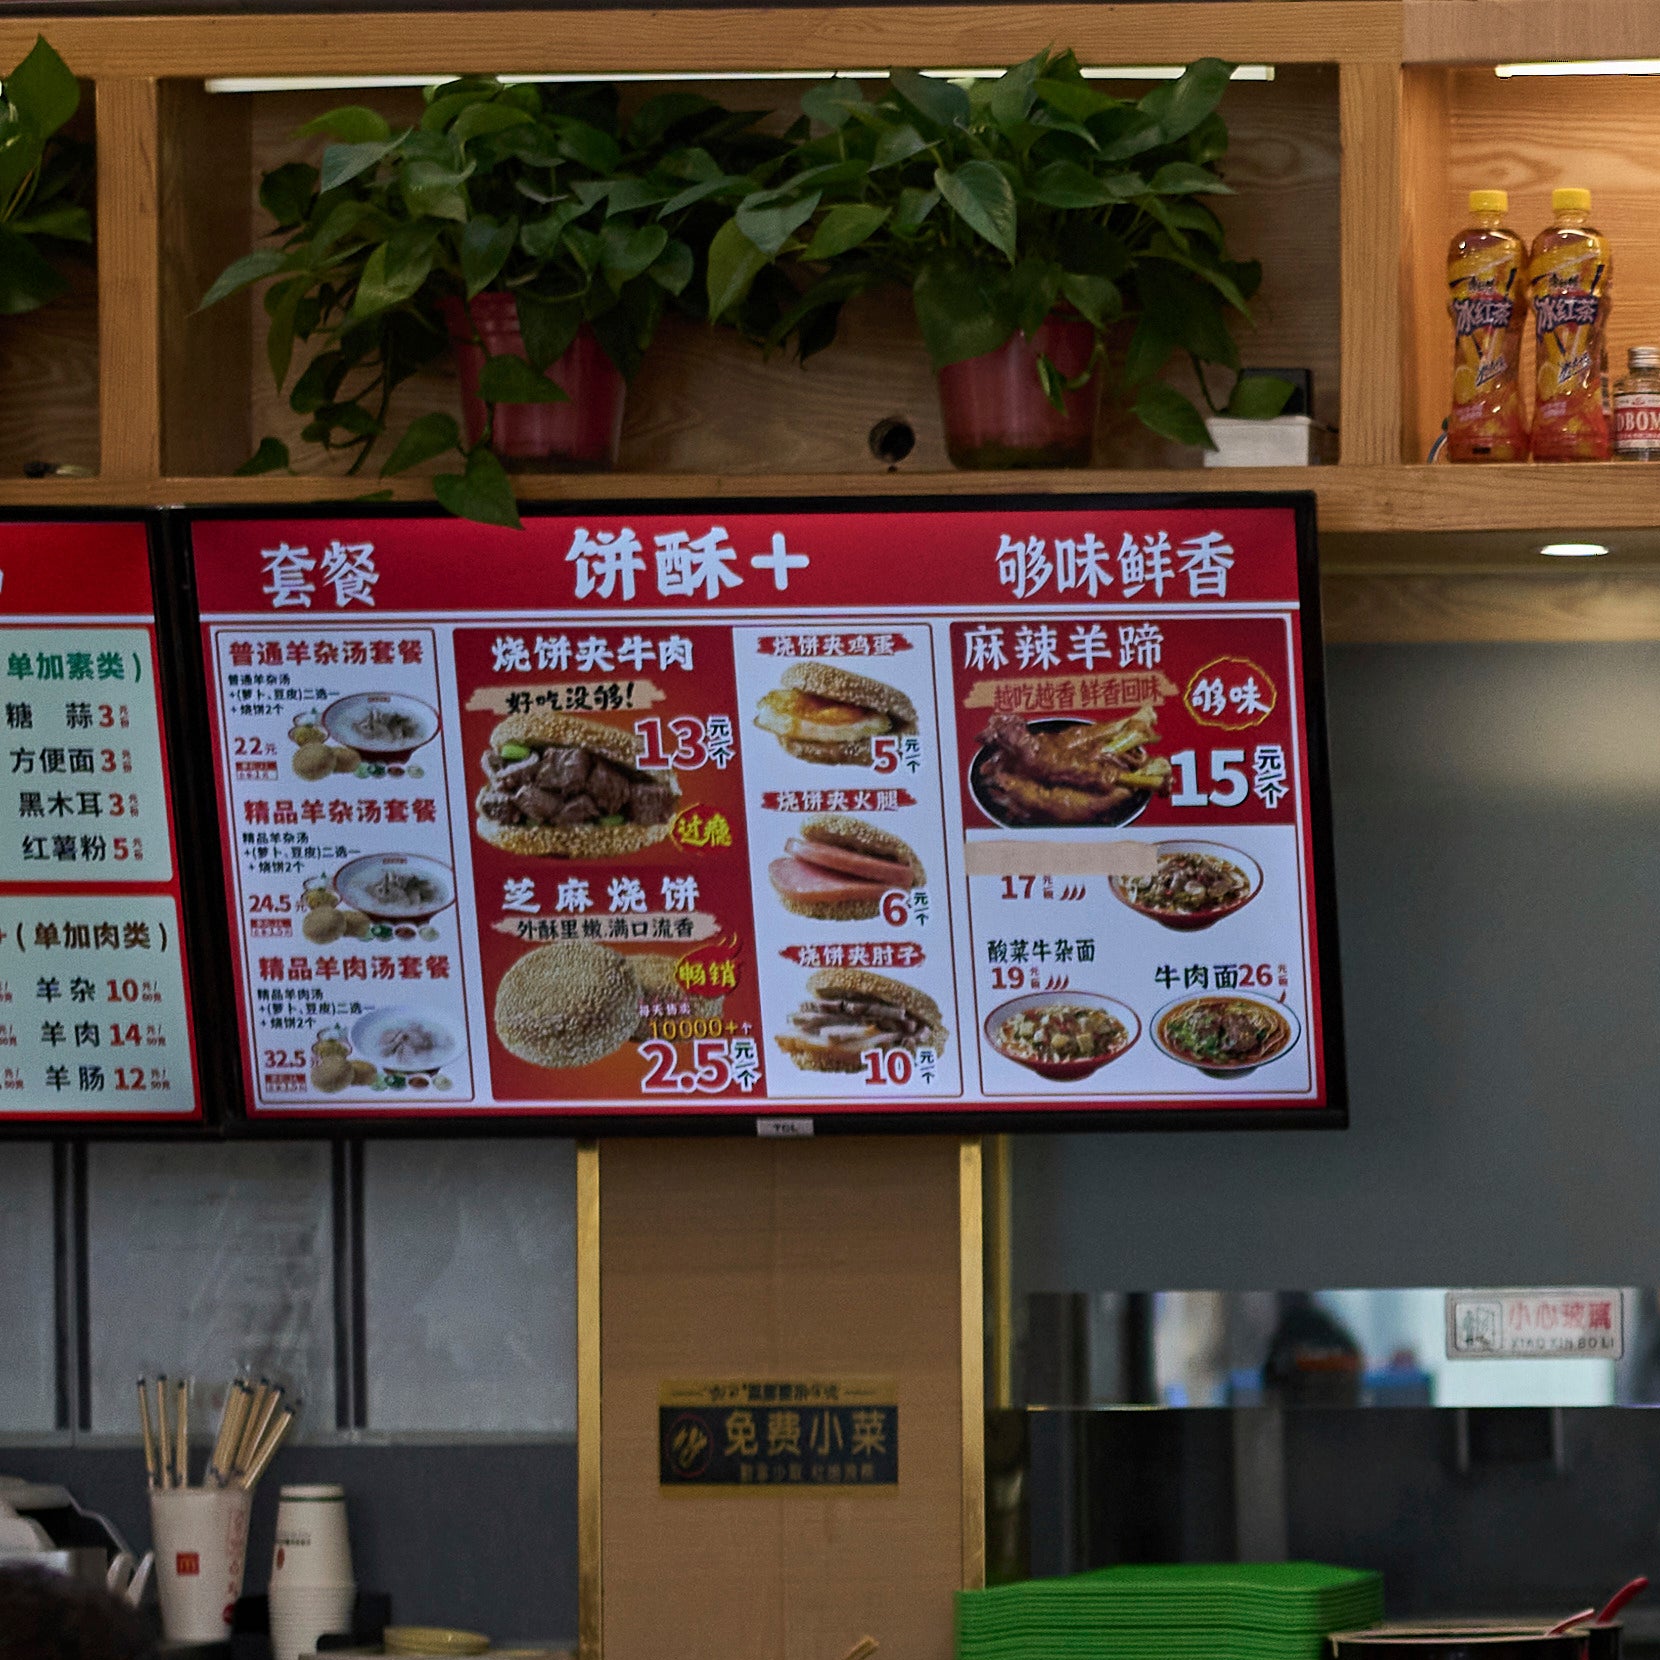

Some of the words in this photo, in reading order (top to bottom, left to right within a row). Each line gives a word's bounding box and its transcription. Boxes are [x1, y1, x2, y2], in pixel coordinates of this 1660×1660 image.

[260, 540, 380, 609] 套餐
[995, 531, 1235, 599] 够味鲜香
[229, 639, 425, 667] 普通羊杂汤套餐
[491, 635, 694, 673] 烧饼夹牛肉
[773, 635, 895, 656] 烧饼夹鸡蛋
[964, 624, 1164, 671] 麻辣羊蹄
[994, 682, 1077, 713] 越吃越香
[1079, 677, 1164, 709] 鲜香回味
[1190, 676, 1271, 716] 够味
[98, 704, 115, 728] 3
[634, 716, 708, 770] 13
[872, 738, 900, 775] 5
[10, 747, 95, 774] 方便面
[101, 748, 117, 773] 3
[1170, 748, 1250, 807] 15
[19, 791, 103, 818] 黑木耳
[109, 793, 125, 817] 3
[244, 797, 436, 824] 精品羊杂汤套餐
[777, 790, 900, 812] 烧饼夹火腿
[677, 812, 732, 848] 过瘾
[22, 835, 107, 862] 红薯粉
[113, 838, 129, 861] 5
[502, 876, 700, 913] 芝麻烧饼
[1001, 875, 1036, 900] 17
[880, 891, 909, 927] 6
[799, 945, 919, 967] 烧饼夹肘子
[987, 938, 1096, 964] 酸菜牛杂面
[259, 955, 450, 981] 精品羊肉汤套餐
[678, 959, 738, 989] 畅销
[991, 966, 1025, 990] 19
[1154, 964, 1239, 990] 牛肉面
[1238, 963, 1273, 987] 26
[36, 977, 96, 1002] 羊杂
[107, 979, 139, 1002] 10
[41, 1020, 100, 1047] 羊肉
[110, 1023, 142, 1046] 14
[46, 1064, 105, 1091] 羊肠
[114, 1068, 146, 1091] 12
[637, 1038, 732, 1094] 2.5
[863, 1050, 912, 1086] 10
[723, 1410, 888, 1458] 免费小菜
